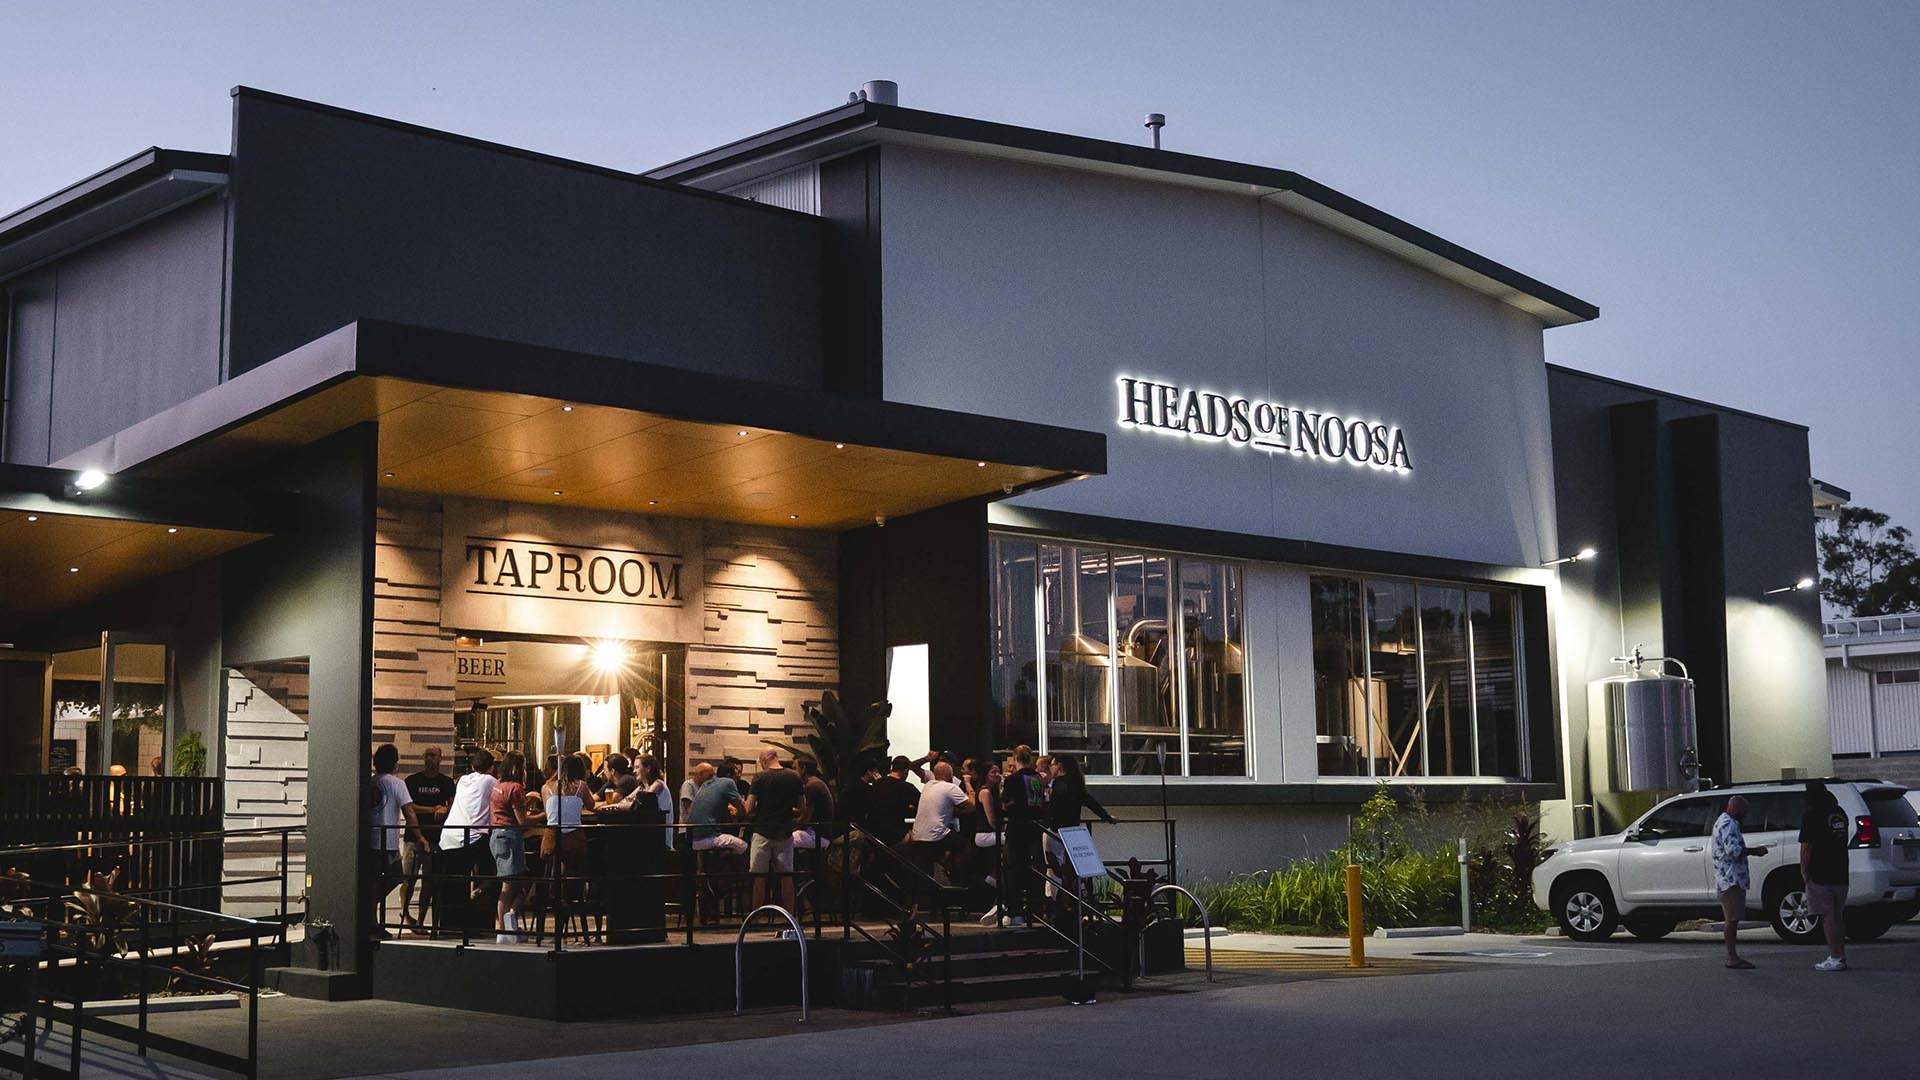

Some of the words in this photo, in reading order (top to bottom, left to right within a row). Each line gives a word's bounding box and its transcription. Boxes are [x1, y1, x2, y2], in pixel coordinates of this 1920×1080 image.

[1120, 378, 1251, 442] HEADS
[1254, 403, 1290, 436] OF
[1292, 410, 1413, 470] NOOSA
[466, 544, 683, 600] TAPROOM
[457, 657, 507, 677] BEER
